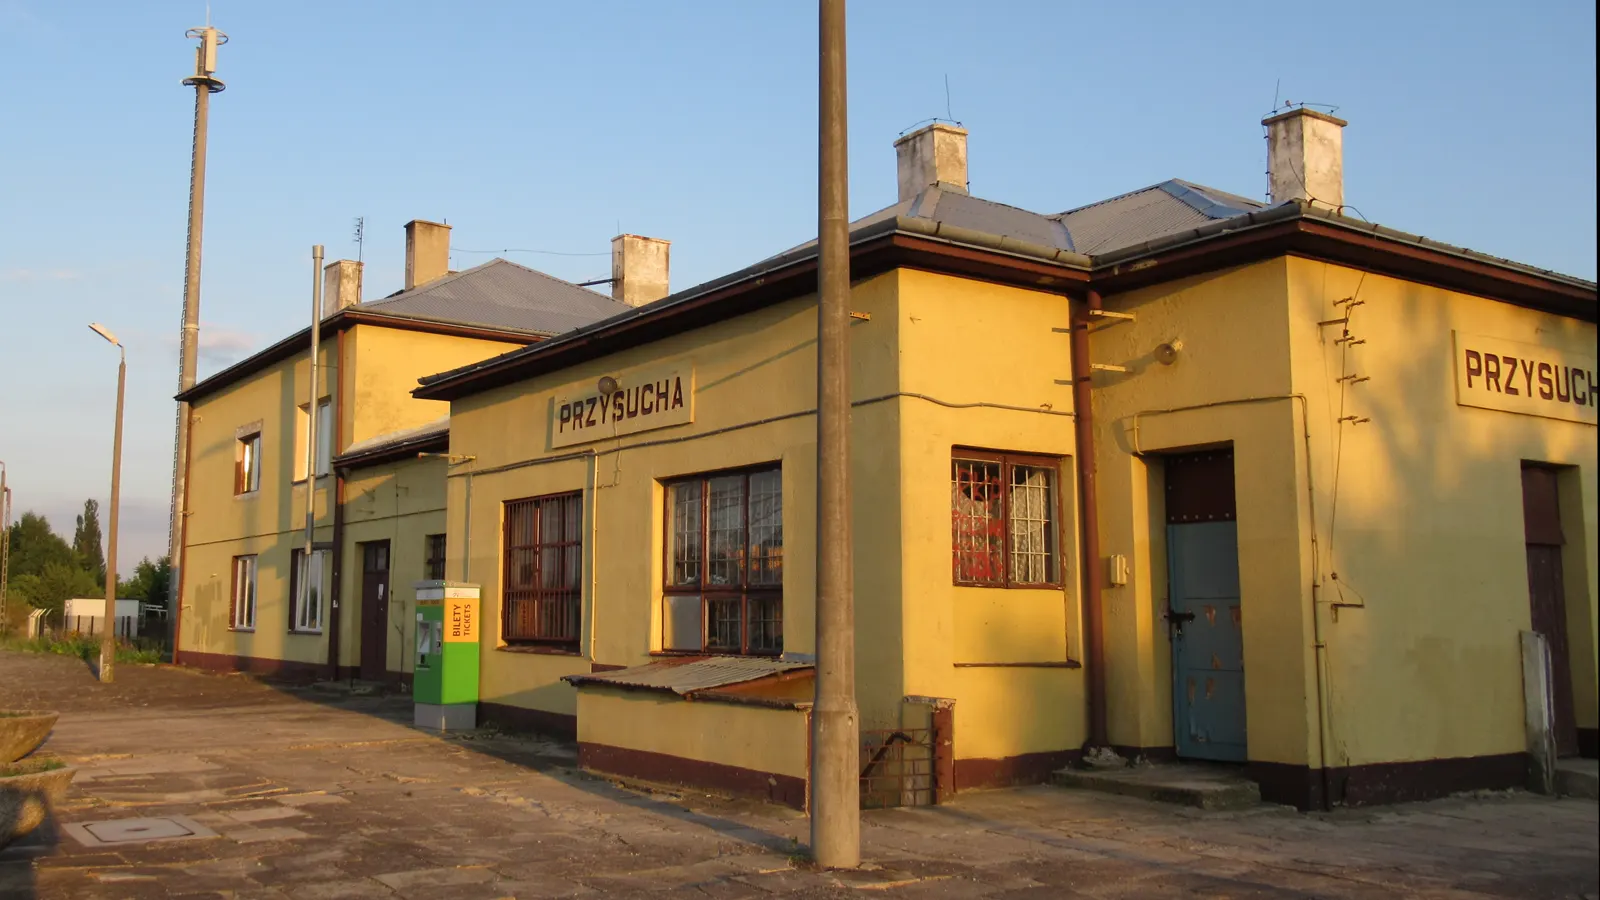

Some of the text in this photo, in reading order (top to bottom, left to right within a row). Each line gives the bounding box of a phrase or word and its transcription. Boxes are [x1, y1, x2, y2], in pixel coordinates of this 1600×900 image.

[560, 376, 683, 433] PRZYSUCHA
[453, 604, 461, 636] BILETY
[463, 604, 471, 636] TICKETS
